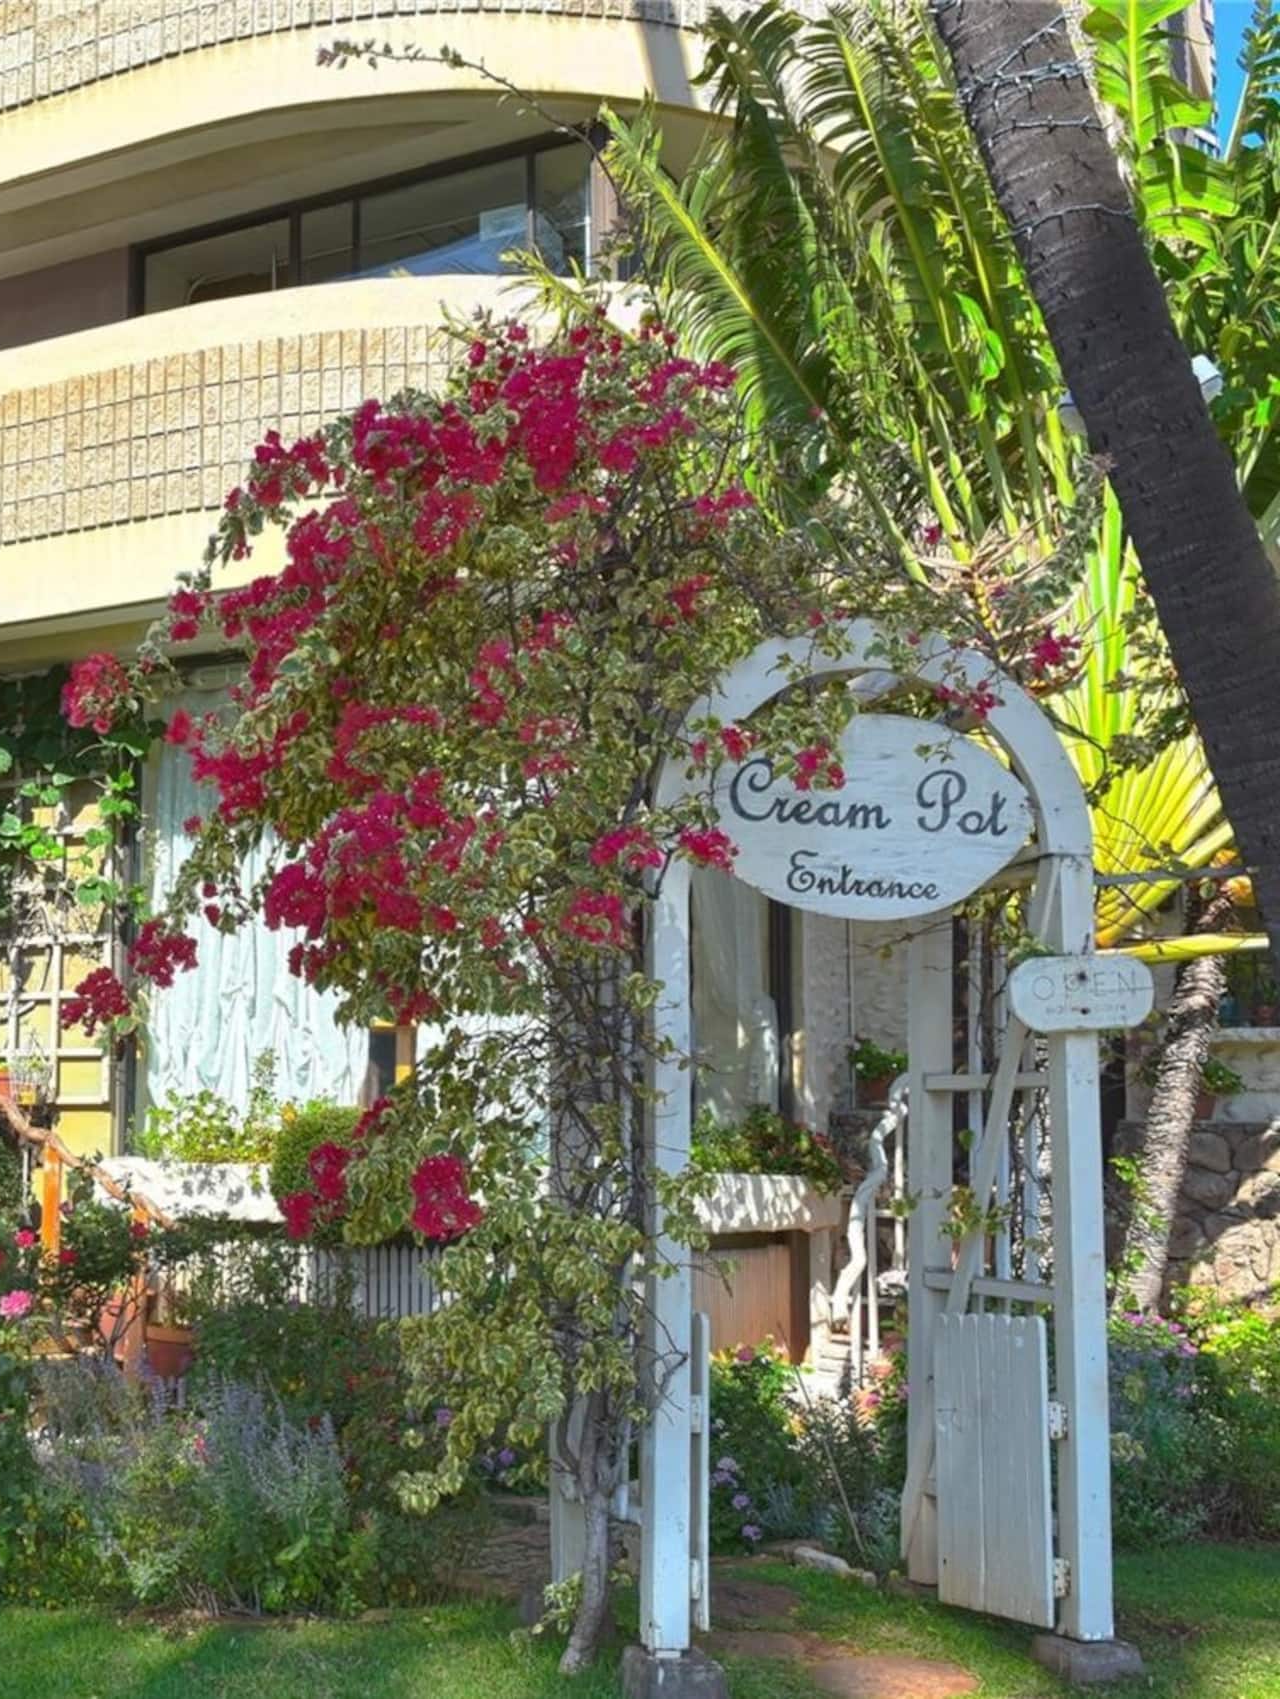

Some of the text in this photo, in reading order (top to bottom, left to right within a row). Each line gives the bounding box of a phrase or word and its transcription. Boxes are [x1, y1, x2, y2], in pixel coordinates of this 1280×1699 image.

[729, 757, 1008, 836] Cream Pot
[786, 850, 940, 900] Entrance
[1031, 969, 1137, 1001] OPEN
